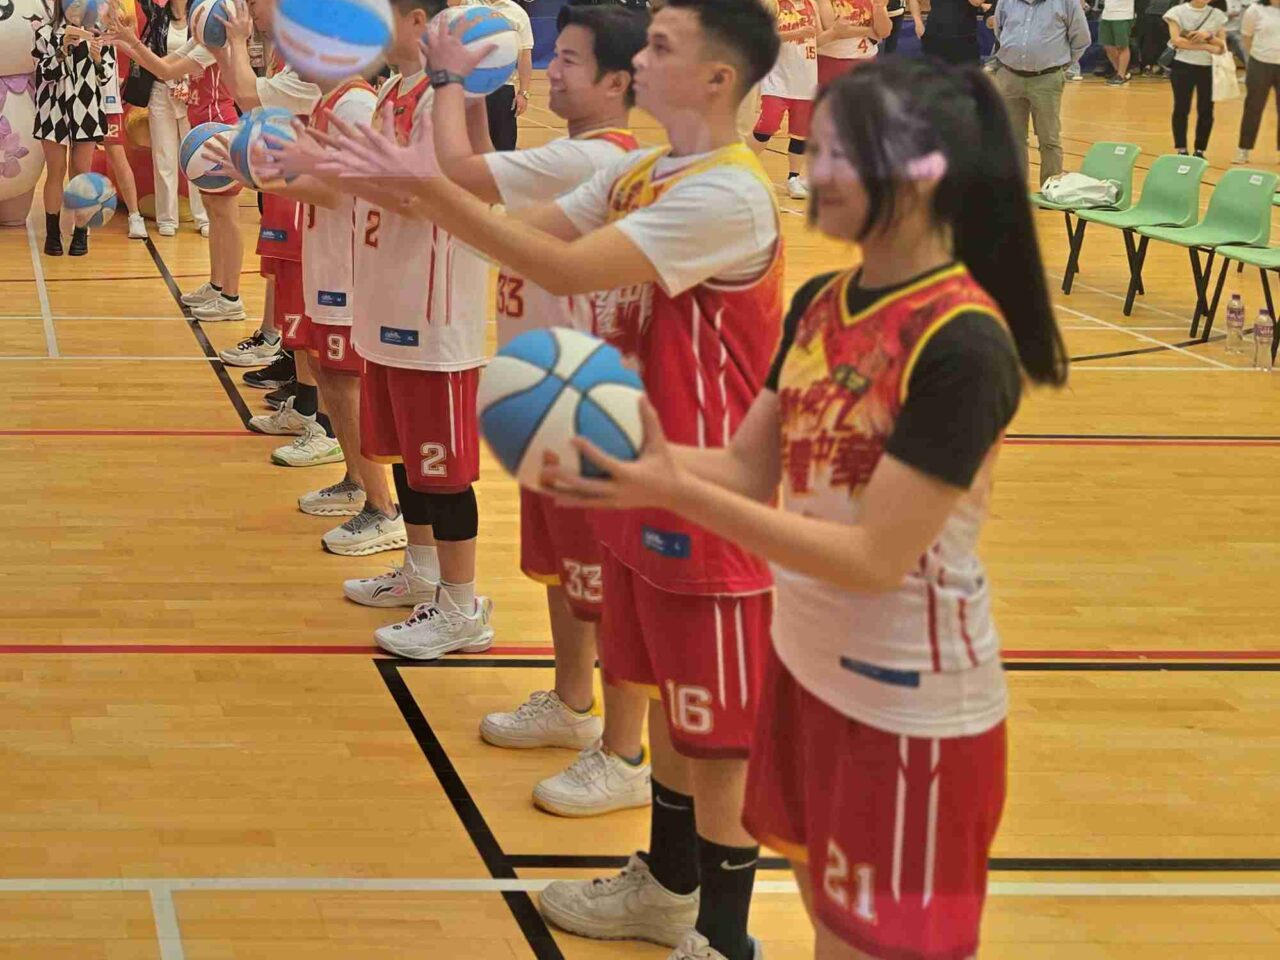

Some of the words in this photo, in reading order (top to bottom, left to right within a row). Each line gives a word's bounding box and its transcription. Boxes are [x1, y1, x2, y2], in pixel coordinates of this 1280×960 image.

[805, 46, 816, 60] 15
[857, 39, 869, 53] 4
[365, 211, 381, 249] 2
[497, 273, 524, 319] 33
[284, 313, 302, 339] 7
[327, 333, 345, 361] 9
[420, 442, 447, 478] 2
[562, 558, 602, 603] 33
[665, 679, 713, 735] 16
[823, 837, 877, 924] 21
